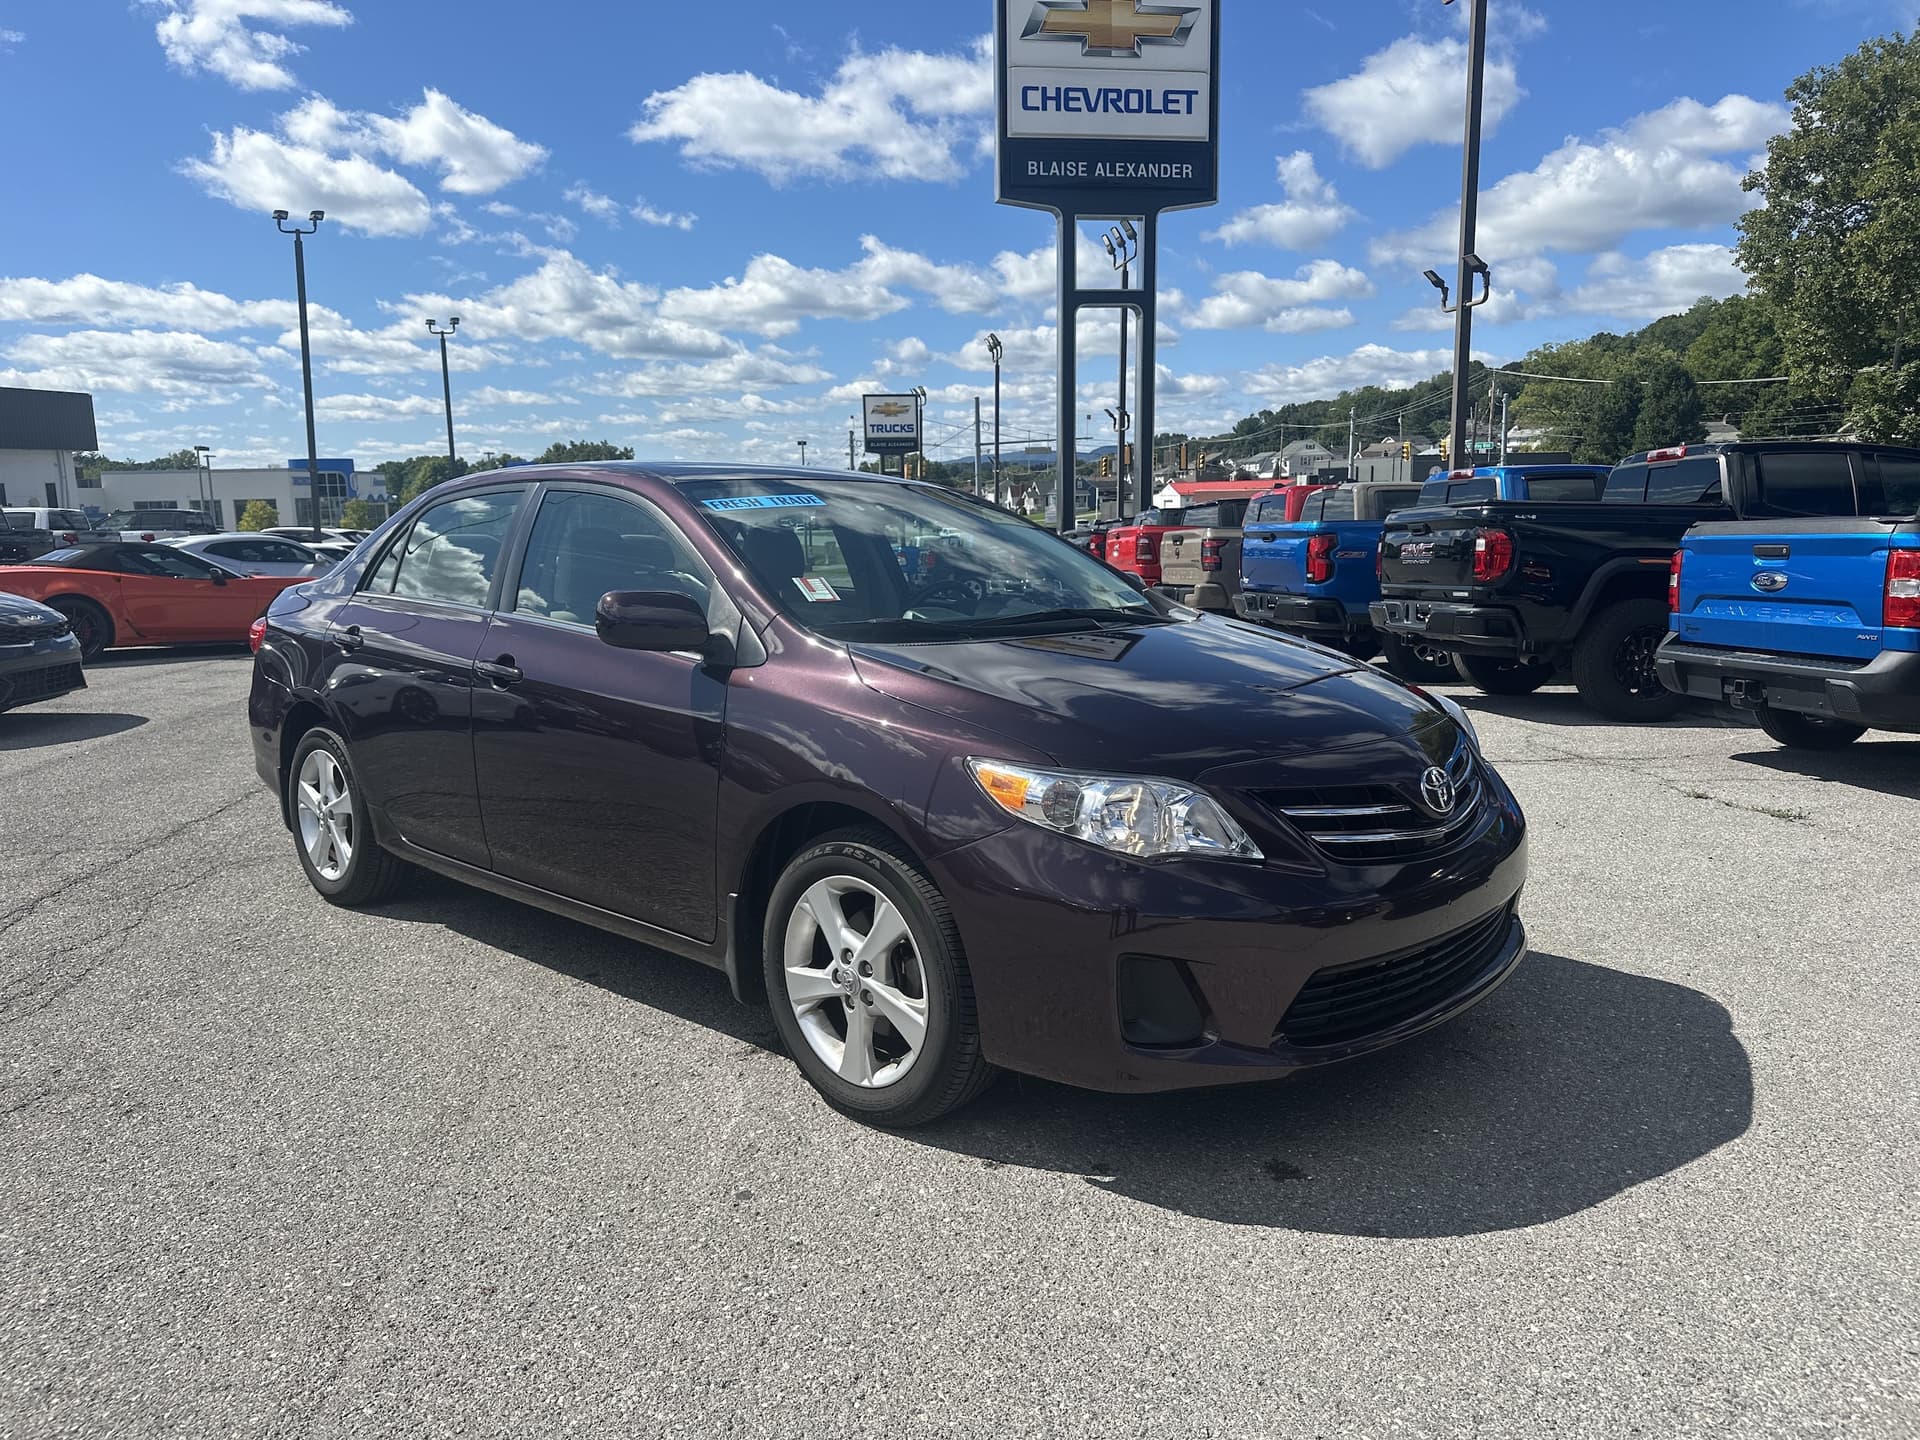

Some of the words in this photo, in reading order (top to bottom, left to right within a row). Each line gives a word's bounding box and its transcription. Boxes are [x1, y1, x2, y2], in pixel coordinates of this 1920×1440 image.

[1021, 85, 1199, 115] CHEVROLET
[1027, 160, 1088, 177] BLAISE
[1094, 161, 1193, 179] ALEXANDER
[869, 423, 914, 433] TRUCKS
[709, 499, 763, 510] FRESH
[768, 495, 818, 505] TRADE
